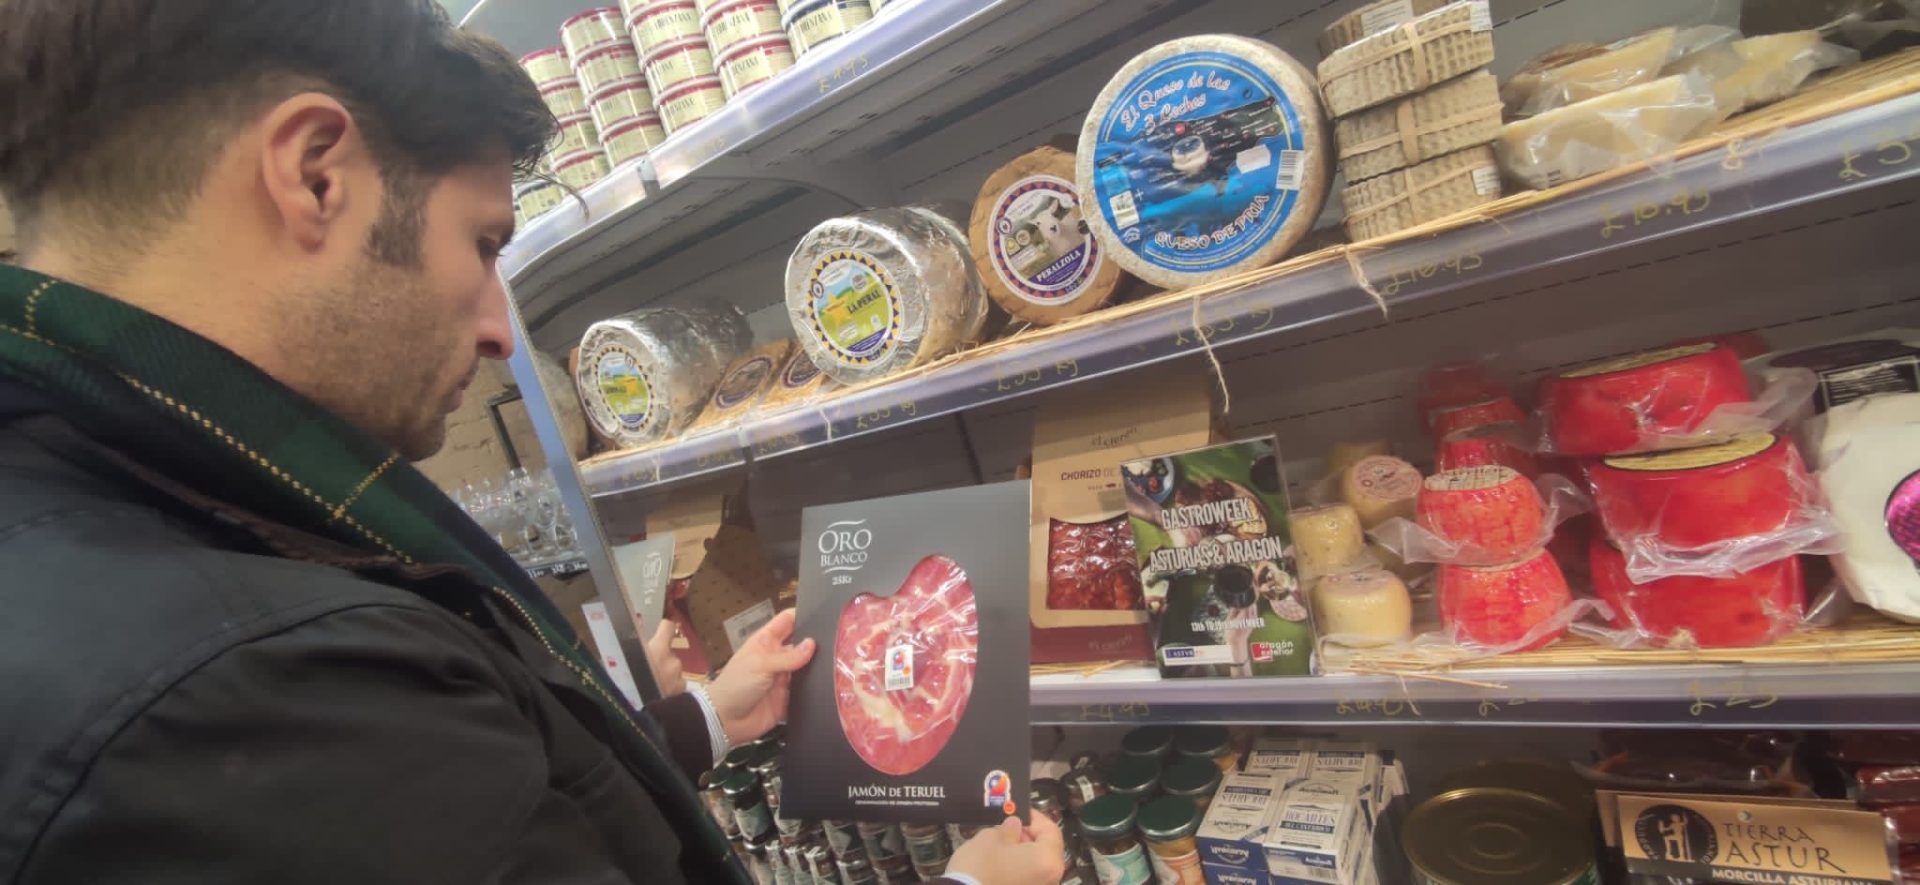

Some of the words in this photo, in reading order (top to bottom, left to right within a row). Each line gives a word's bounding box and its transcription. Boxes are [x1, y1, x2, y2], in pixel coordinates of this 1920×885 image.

[1138, 79, 1184, 111] Queso
[1187, 72, 1204, 89] de
[1143, 114, 1156, 134] 3
[1159, 93, 1207, 123] Leches
[1155, 231, 1210, 250] QUESO
[1211, 226, 1237, 245] DE
[1235, 195, 1270, 231] PRIA
[1036, 249, 1081, 282] PERALZOLA
[857, 289, 881, 309] PERAL
[1061, 468, 1102, 481] CHORIZO
[1161, 498, 1252, 530] GASTROWEEK
[818, 528, 872, 554] ORO
[820, 551, 868, 568] BLANCO
[1150, 545, 1212, 573] ASTURIAS
[1213, 544, 1224, 566] &
[1259, 642, 1294, 653] aragón
[848, 785, 886, 799] JAMÓN
[889, 788, 901, 797] DE
[903, 785, 945, 798] TERUEL
[1723, 823, 1815, 843] TIERRA
[1725, 842, 1847, 873] ASTUR
[1712, 868, 1785, 885] MORCILLA
